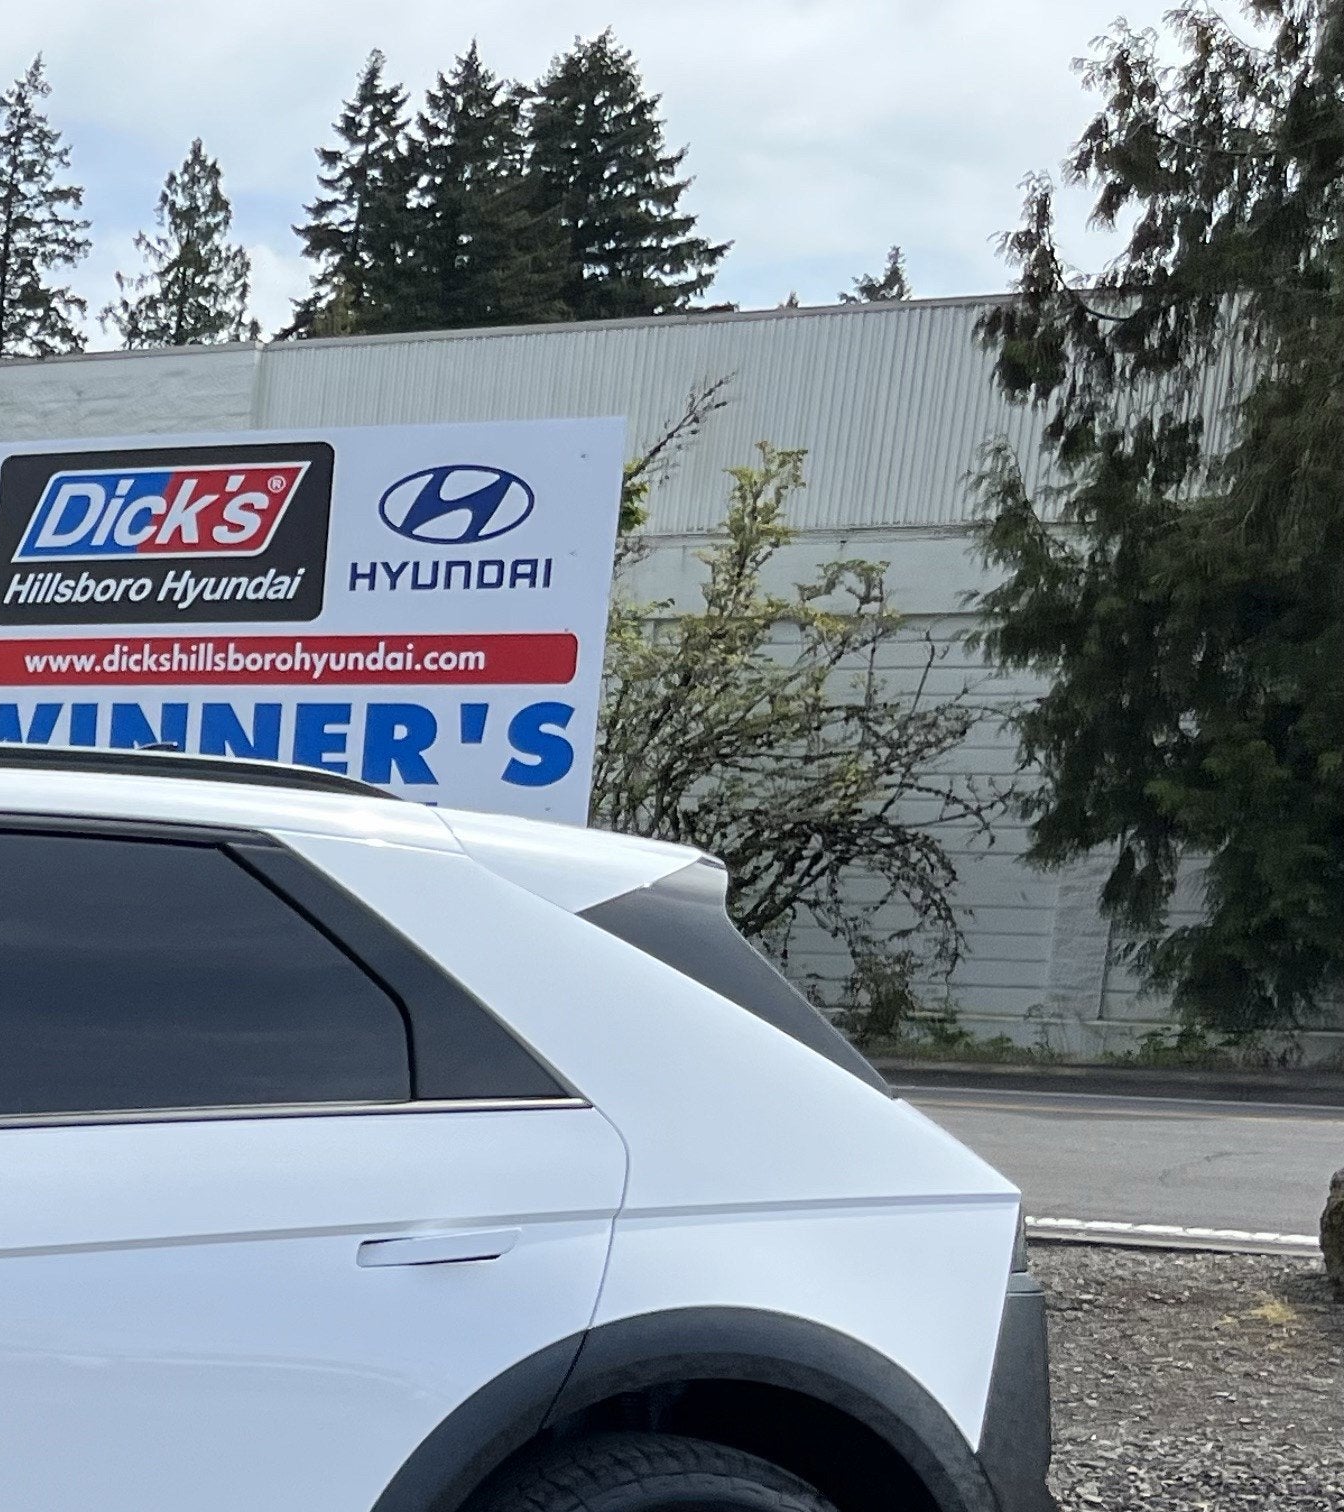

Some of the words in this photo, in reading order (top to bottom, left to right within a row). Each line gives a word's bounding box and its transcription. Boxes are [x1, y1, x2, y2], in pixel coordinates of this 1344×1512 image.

[3, 571, 152, 604] Hillsboro
[157, 568, 305, 610] Hyundai
[349, 558, 552, 591] HYUNDAI
[24, 641, 486, 679] www.dickshillsborohyundai.com
